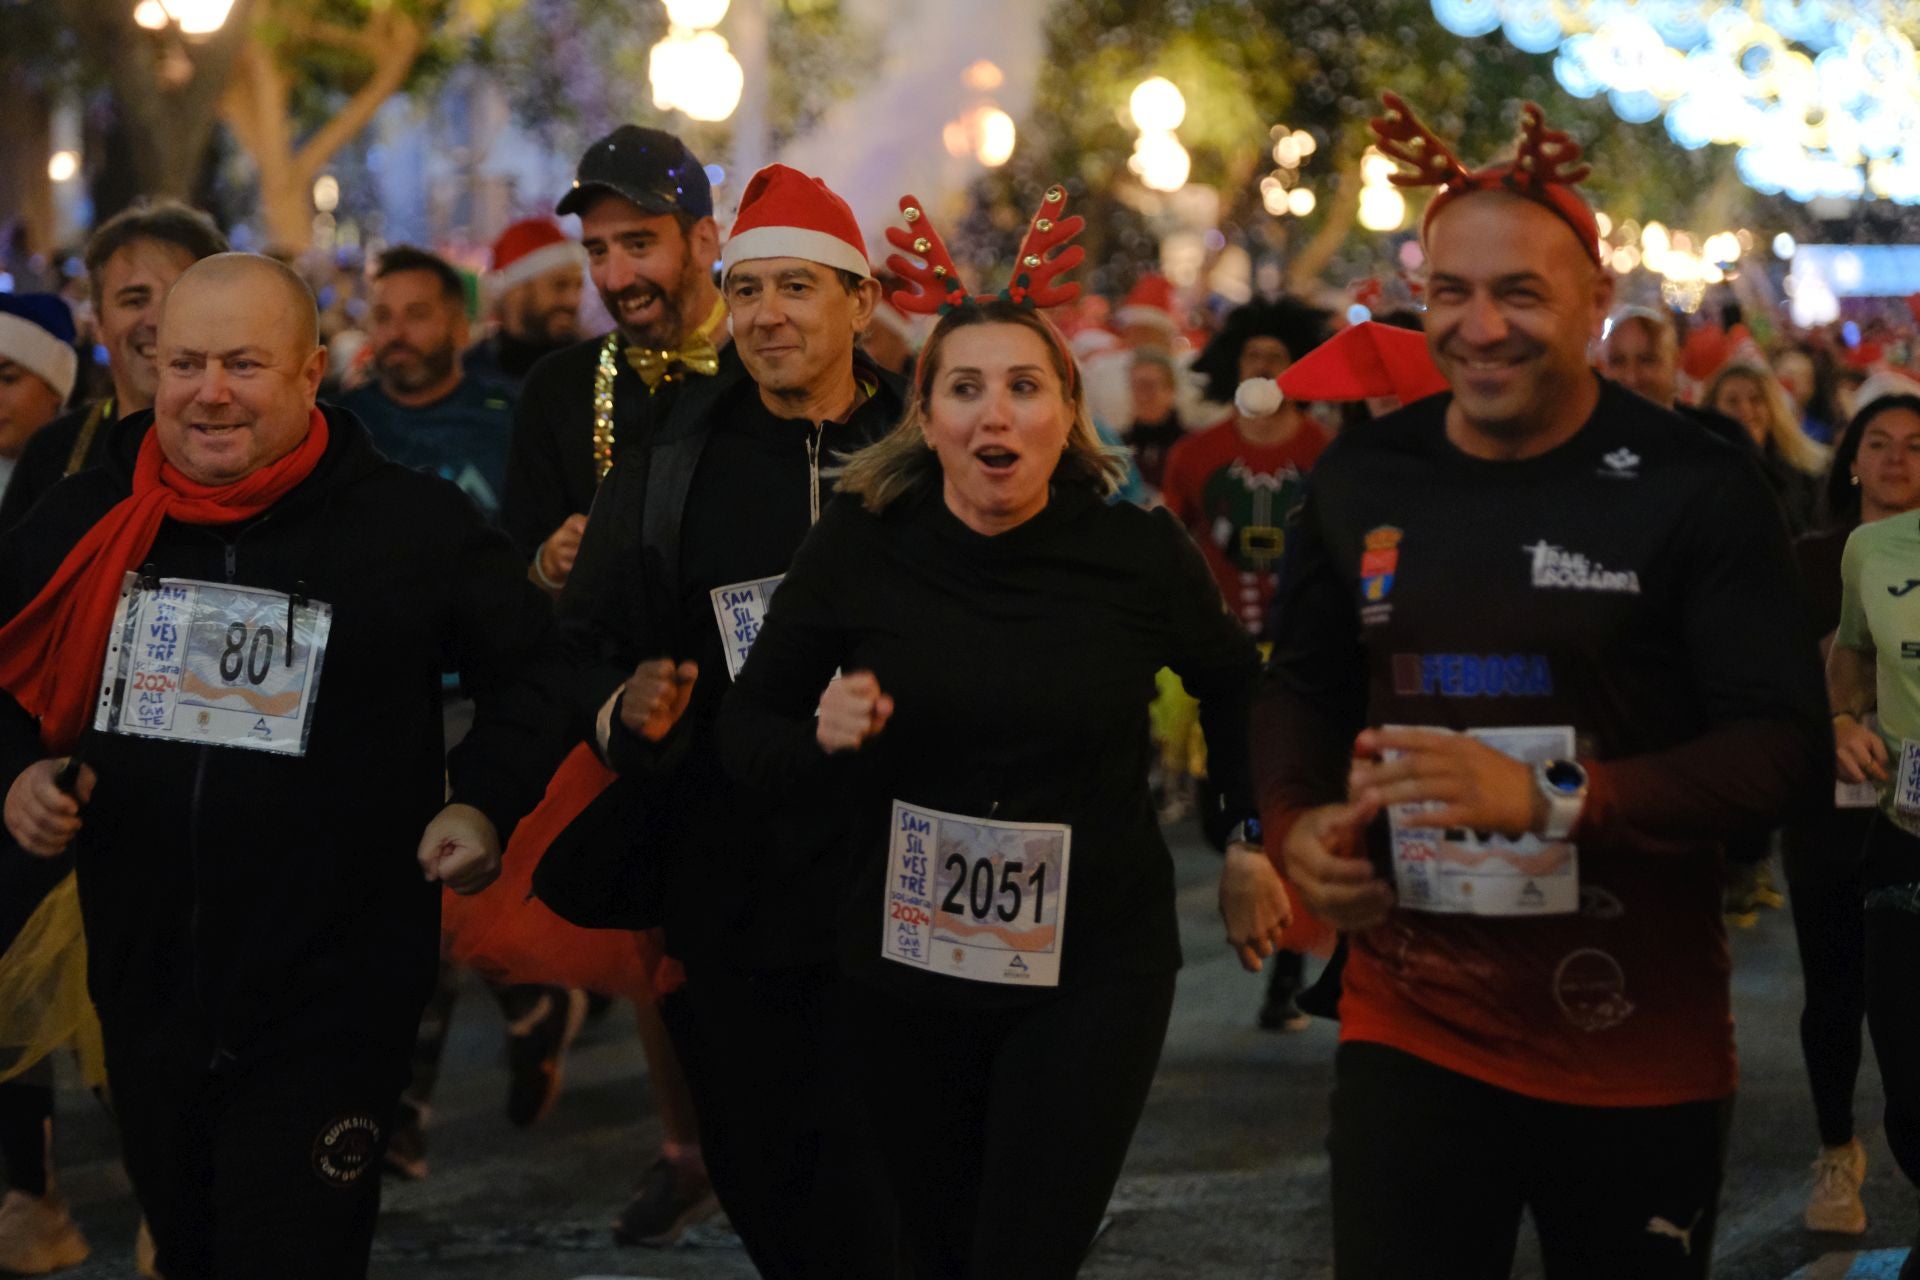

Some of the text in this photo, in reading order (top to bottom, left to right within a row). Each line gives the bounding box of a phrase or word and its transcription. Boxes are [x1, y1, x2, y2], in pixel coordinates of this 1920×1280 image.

[151, 586, 187, 601] SAN
[722, 589, 754, 611] SAN
[150, 623, 177, 643] VES
[219, 622, 274, 686] 80
[133, 671, 177, 692] 2024
[1422, 652, 1554, 697] FEBOSA
[139, 691, 164, 704] ALI
[139, 704, 164, 716] CAN
[139, 715, 165, 726] TE
[901, 811, 930, 835] SAN
[903, 854, 927, 877] VES
[899, 874, 926, 896] TRE
[941, 852, 1047, 924] 2051
[891, 902, 929, 926] 2024
[898, 922, 918, 935] ALI
[898, 935, 920, 948] CAN
[898, 947, 921, 958] TE
